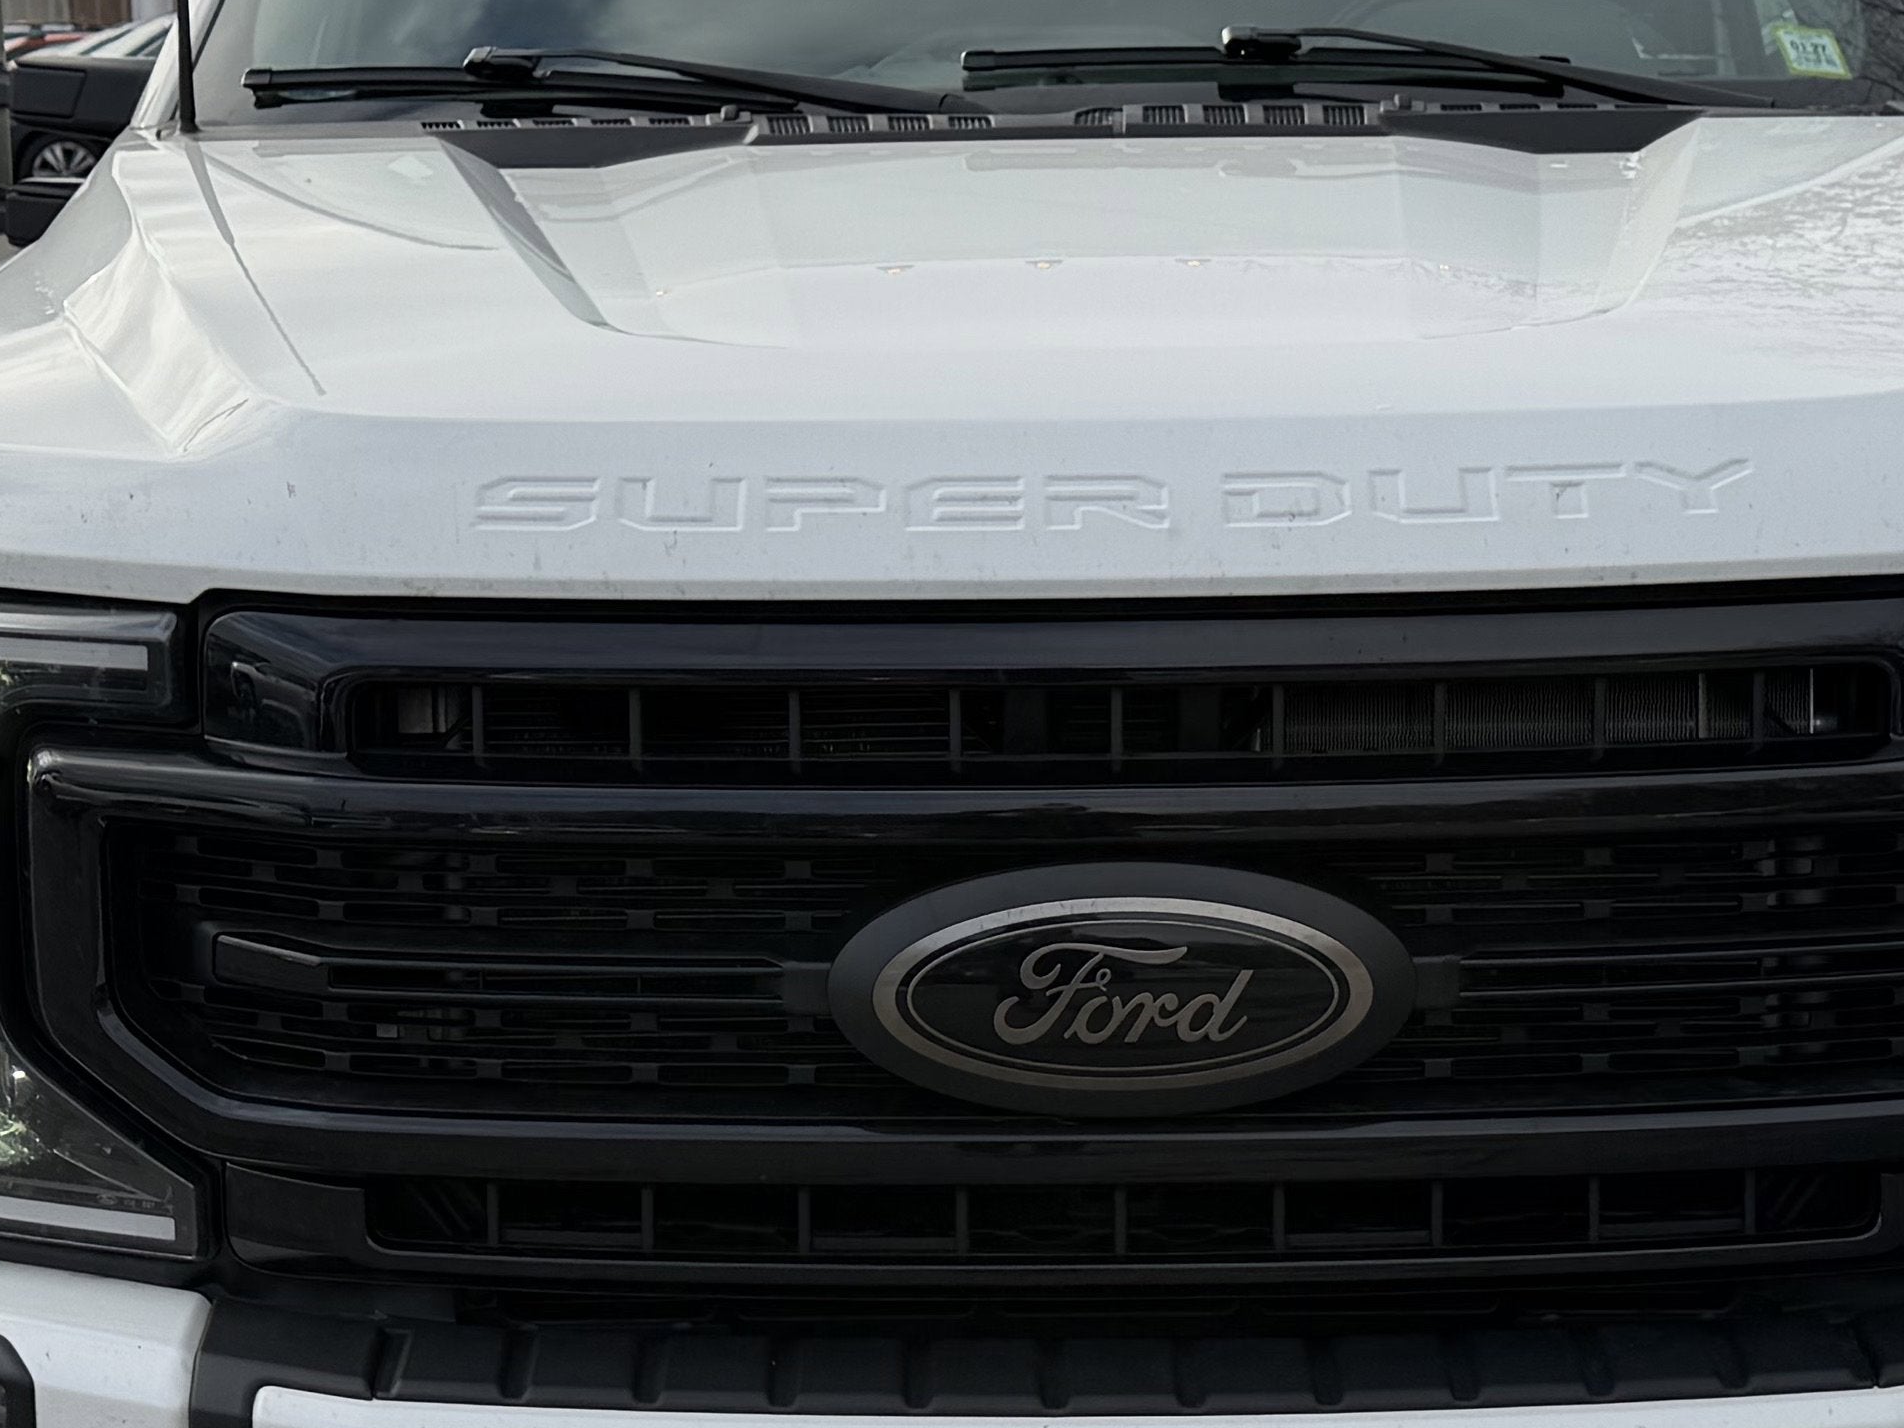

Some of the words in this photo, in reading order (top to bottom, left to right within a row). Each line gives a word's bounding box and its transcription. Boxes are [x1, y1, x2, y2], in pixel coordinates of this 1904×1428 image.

[472, 475, 1171, 530] SUPER
[1220, 458, 1756, 528] DUTY
[993, 942, 1256, 1046] Ford
